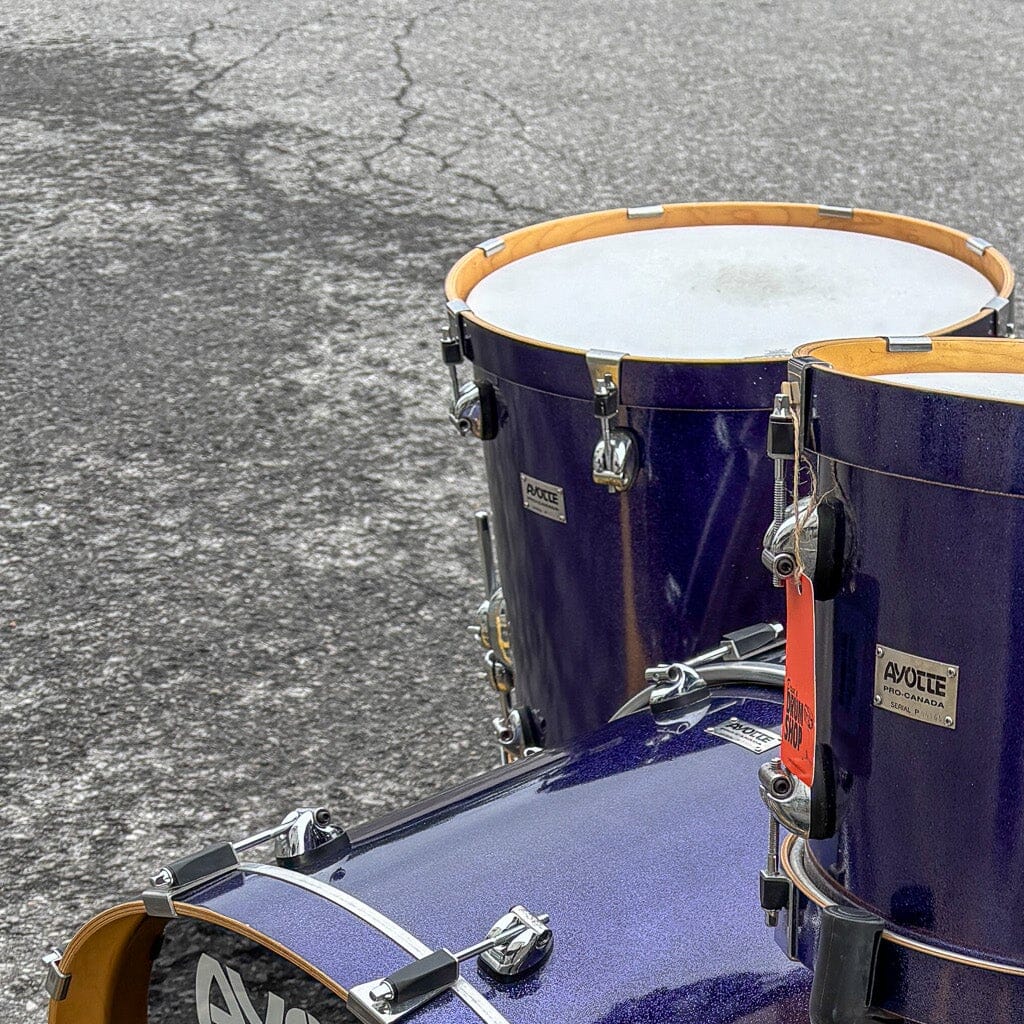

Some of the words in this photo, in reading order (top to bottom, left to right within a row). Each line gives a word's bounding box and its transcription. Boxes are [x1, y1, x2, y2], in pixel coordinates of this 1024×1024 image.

[883, 661, 947, 697] AYOTTE
[883, 685, 945, 709] PRO-CANADA
[890, 701, 911, 714] SERIAL
[784, 714, 803, 751] SHOP
